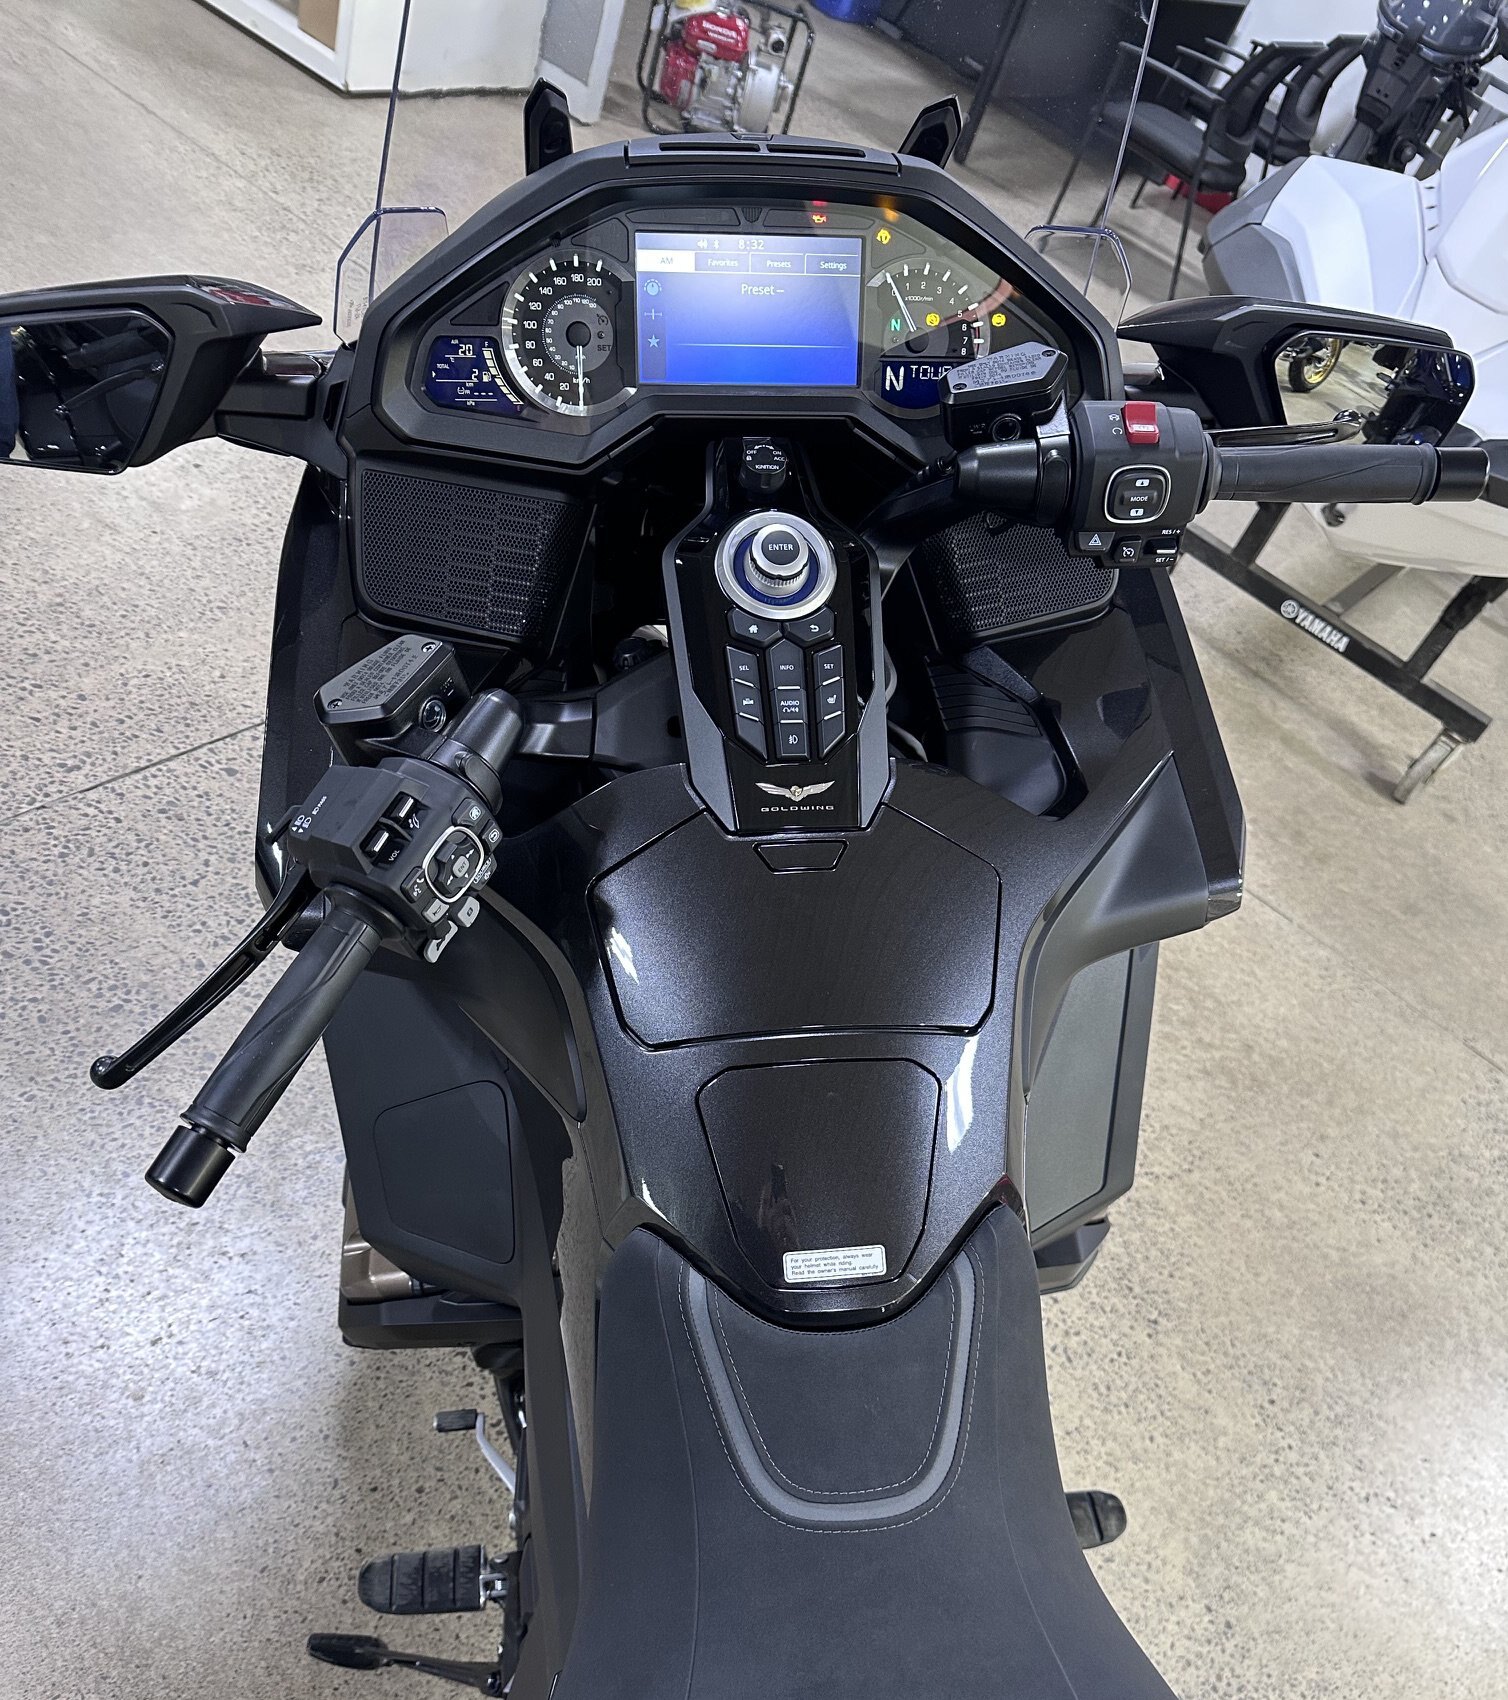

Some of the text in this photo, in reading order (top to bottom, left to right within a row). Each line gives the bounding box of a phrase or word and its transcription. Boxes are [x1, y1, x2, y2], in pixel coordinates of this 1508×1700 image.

[738, 240, 764, 250] 8:32
[708, 258, 738, 267] Favorites
[766, 260, 791, 268] Presets
[820, 261, 848, 270] Settings
[741, 284, 774, 295] Preset
[891, 319, 901, 331] N
[459, 344, 473, 356] 20
[471, 369, 478, 380] 2
[885, 366, 904, 391] N
[1295, 607, 1350, 652] YAMAHA
[389, 850, 400, 861] VOL
[458, 861, 467, 873] ENT
